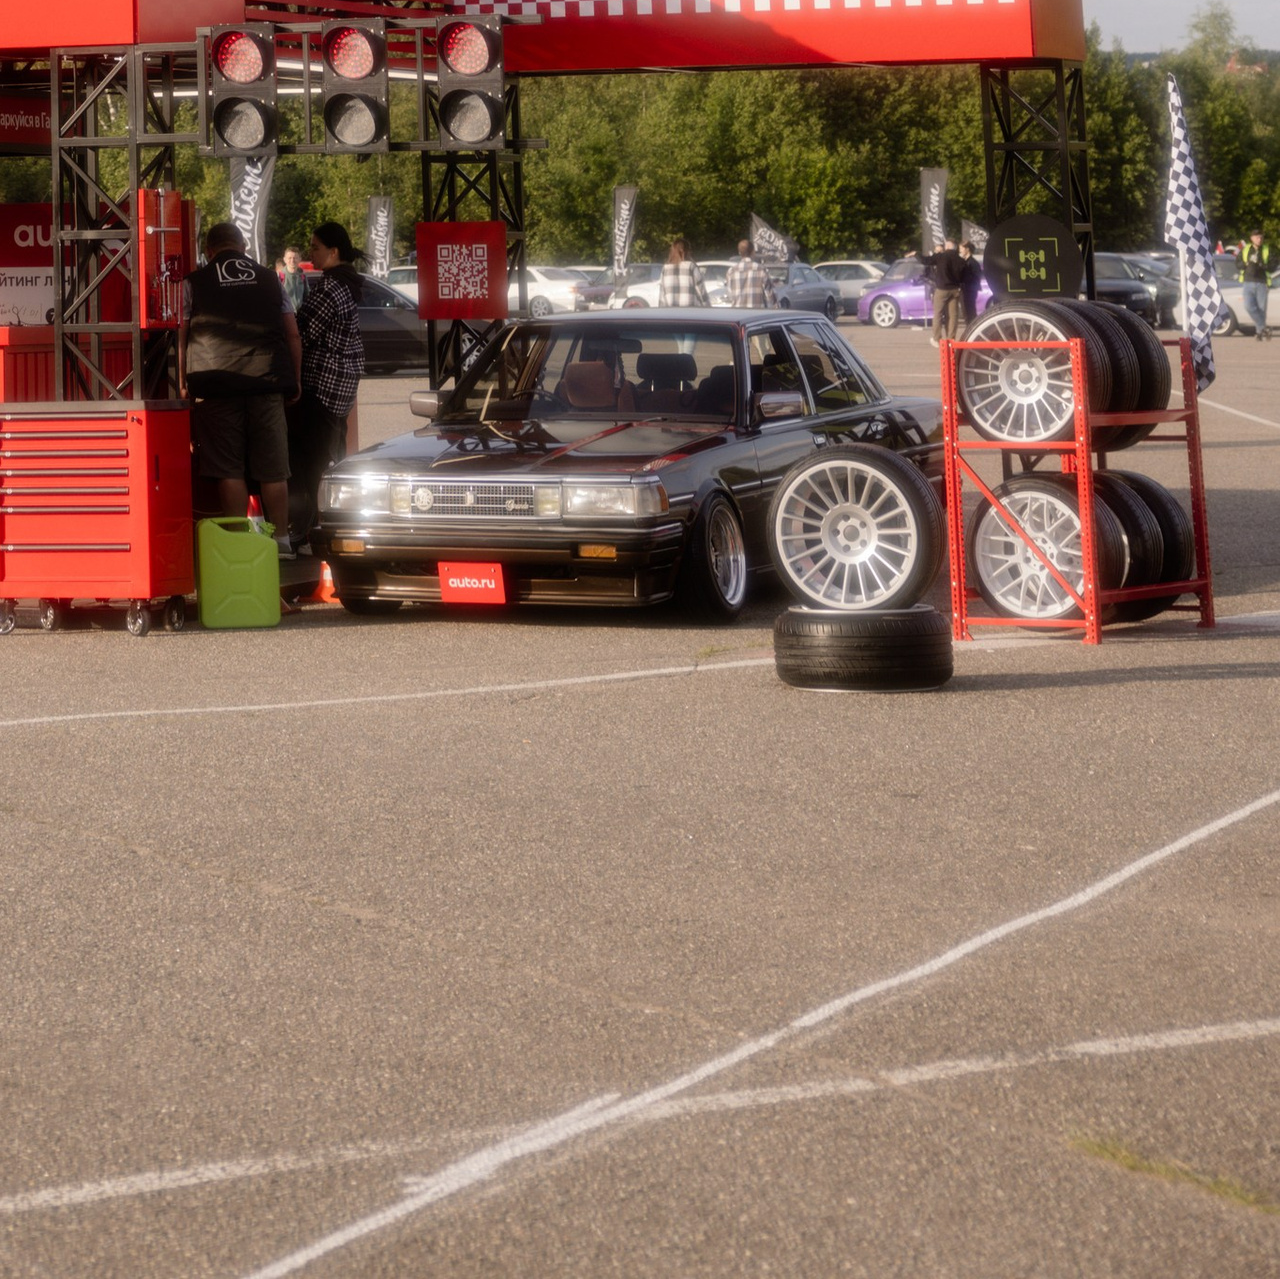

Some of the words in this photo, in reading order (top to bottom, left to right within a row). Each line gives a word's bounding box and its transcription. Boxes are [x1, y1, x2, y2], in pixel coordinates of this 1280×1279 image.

[34, 115, 40, 128] в
[371, 207, 389, 278] Eventism
[448, 576, 496, 589] auto.ru
